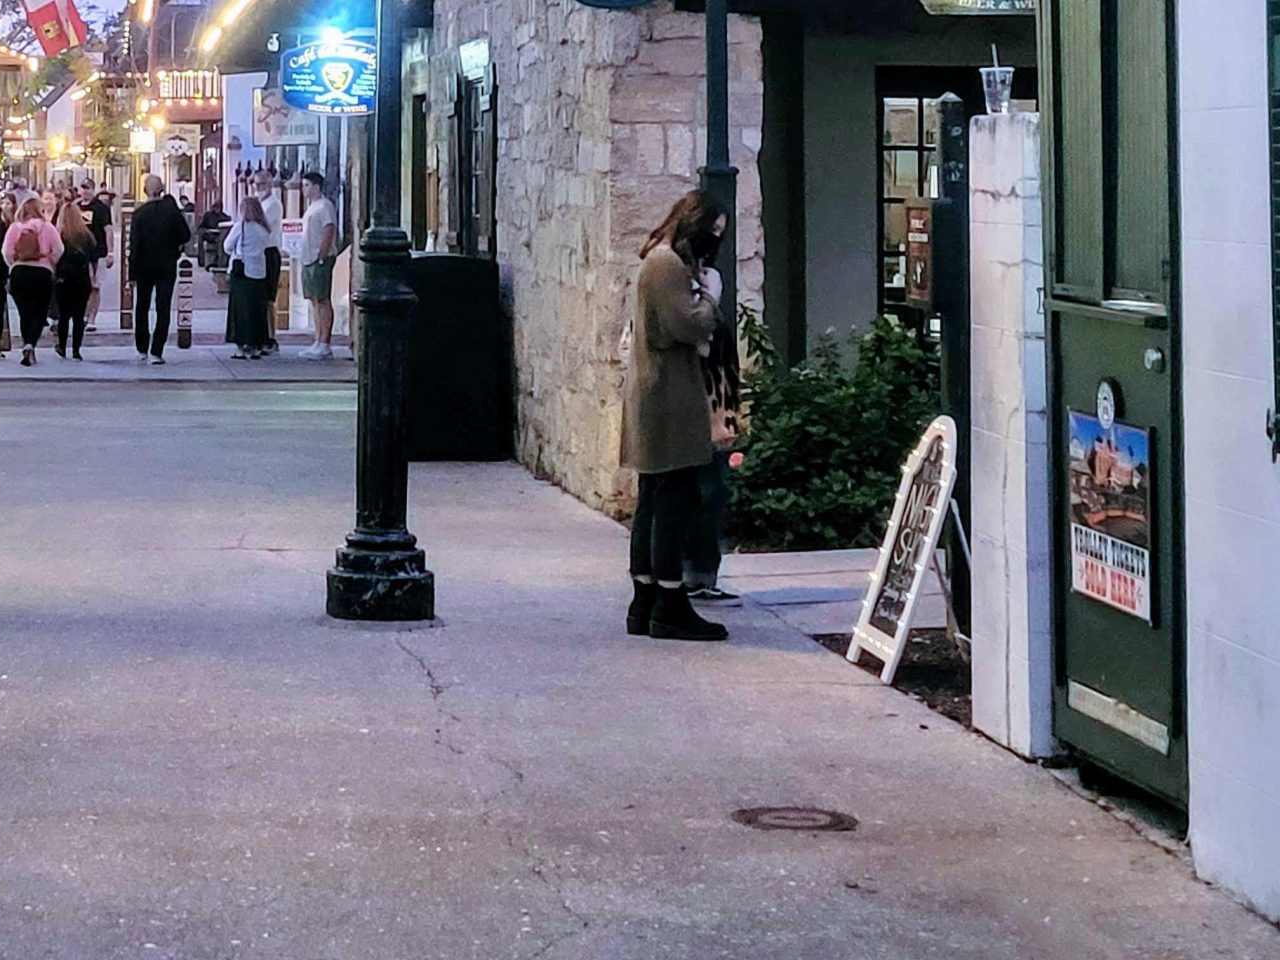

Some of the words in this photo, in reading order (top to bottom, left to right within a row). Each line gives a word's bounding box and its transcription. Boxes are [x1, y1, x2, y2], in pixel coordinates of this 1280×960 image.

[998, 0, 1010, 9] &
[1074, 526, 1108, 563] TROLLEY
[1111, 539, 1146, 578] TICKETS
[1085, 560, 1107, 597] SOLD
[1111, 571, 1136, 611] HERE
